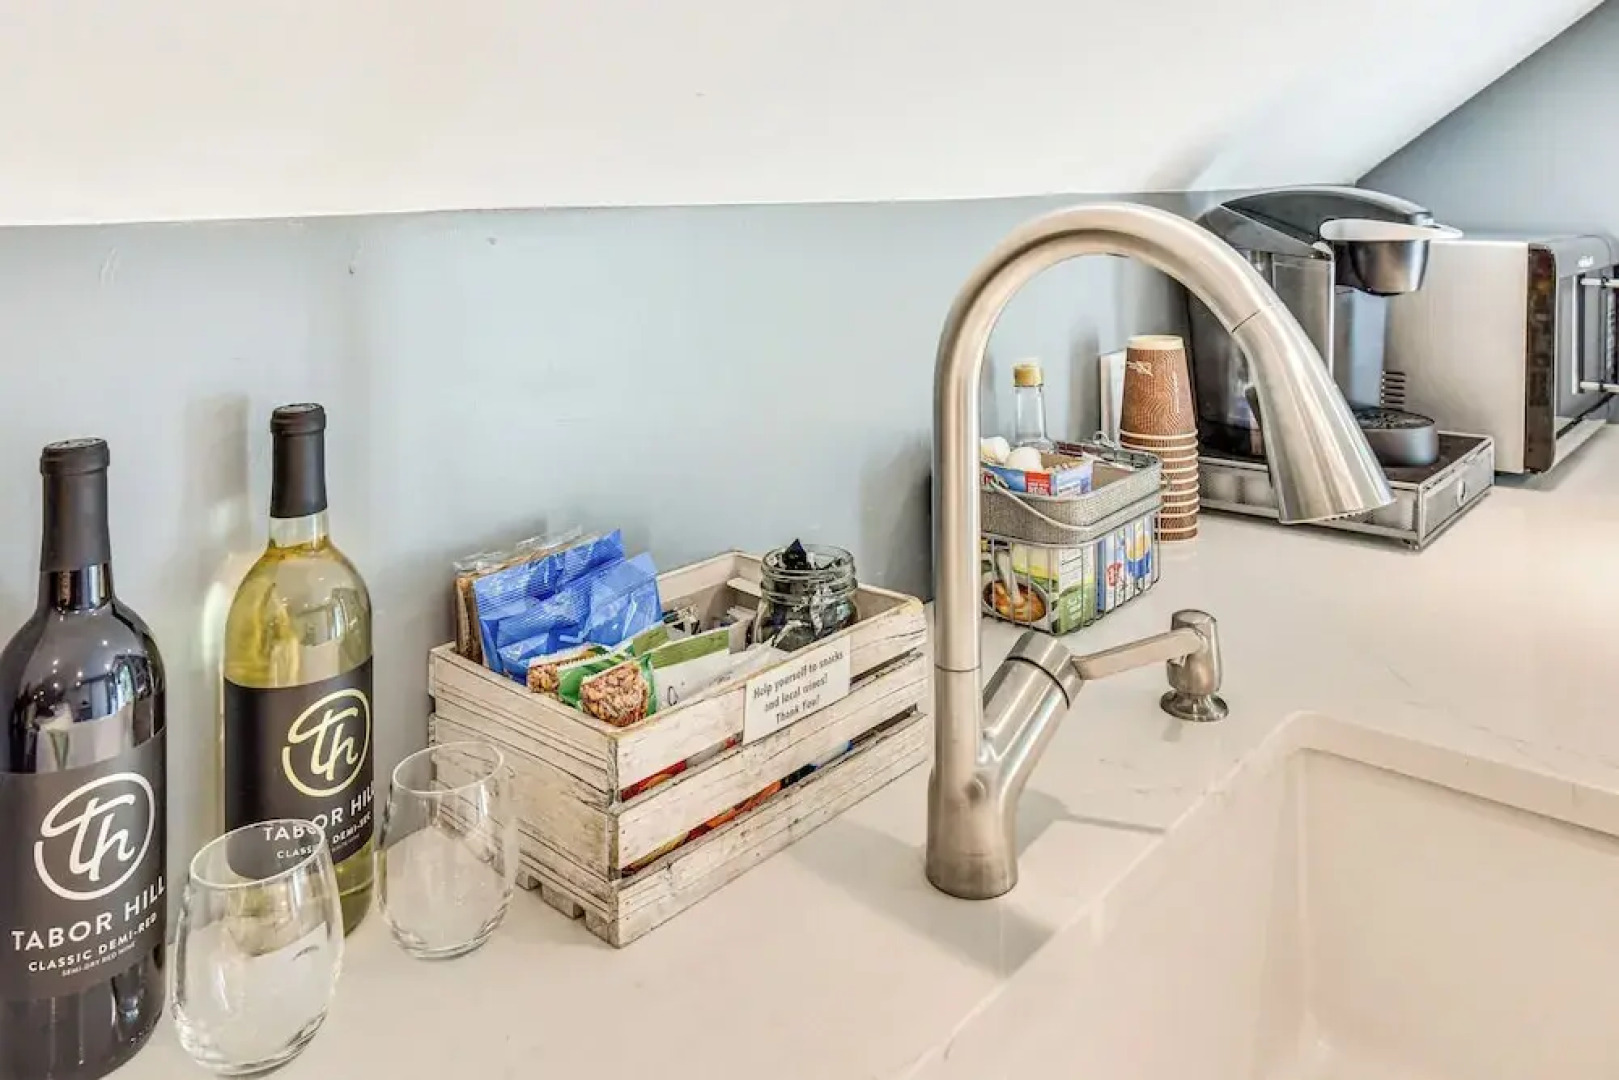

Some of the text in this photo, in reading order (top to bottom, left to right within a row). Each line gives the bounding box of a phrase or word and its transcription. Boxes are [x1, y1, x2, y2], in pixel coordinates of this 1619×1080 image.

[753, 651, 843, 699] Help yourself to snacks
[765, 695, 779, 712] and
[781, 686, 800, 703] local
[776, 704, 799, 724] Thank
[263, 807, 343, 841] TABOR
[11, 875, 165, 951] TABOR HILL
[28, 912, 157, 972] CLASSIC DEMI-RED
